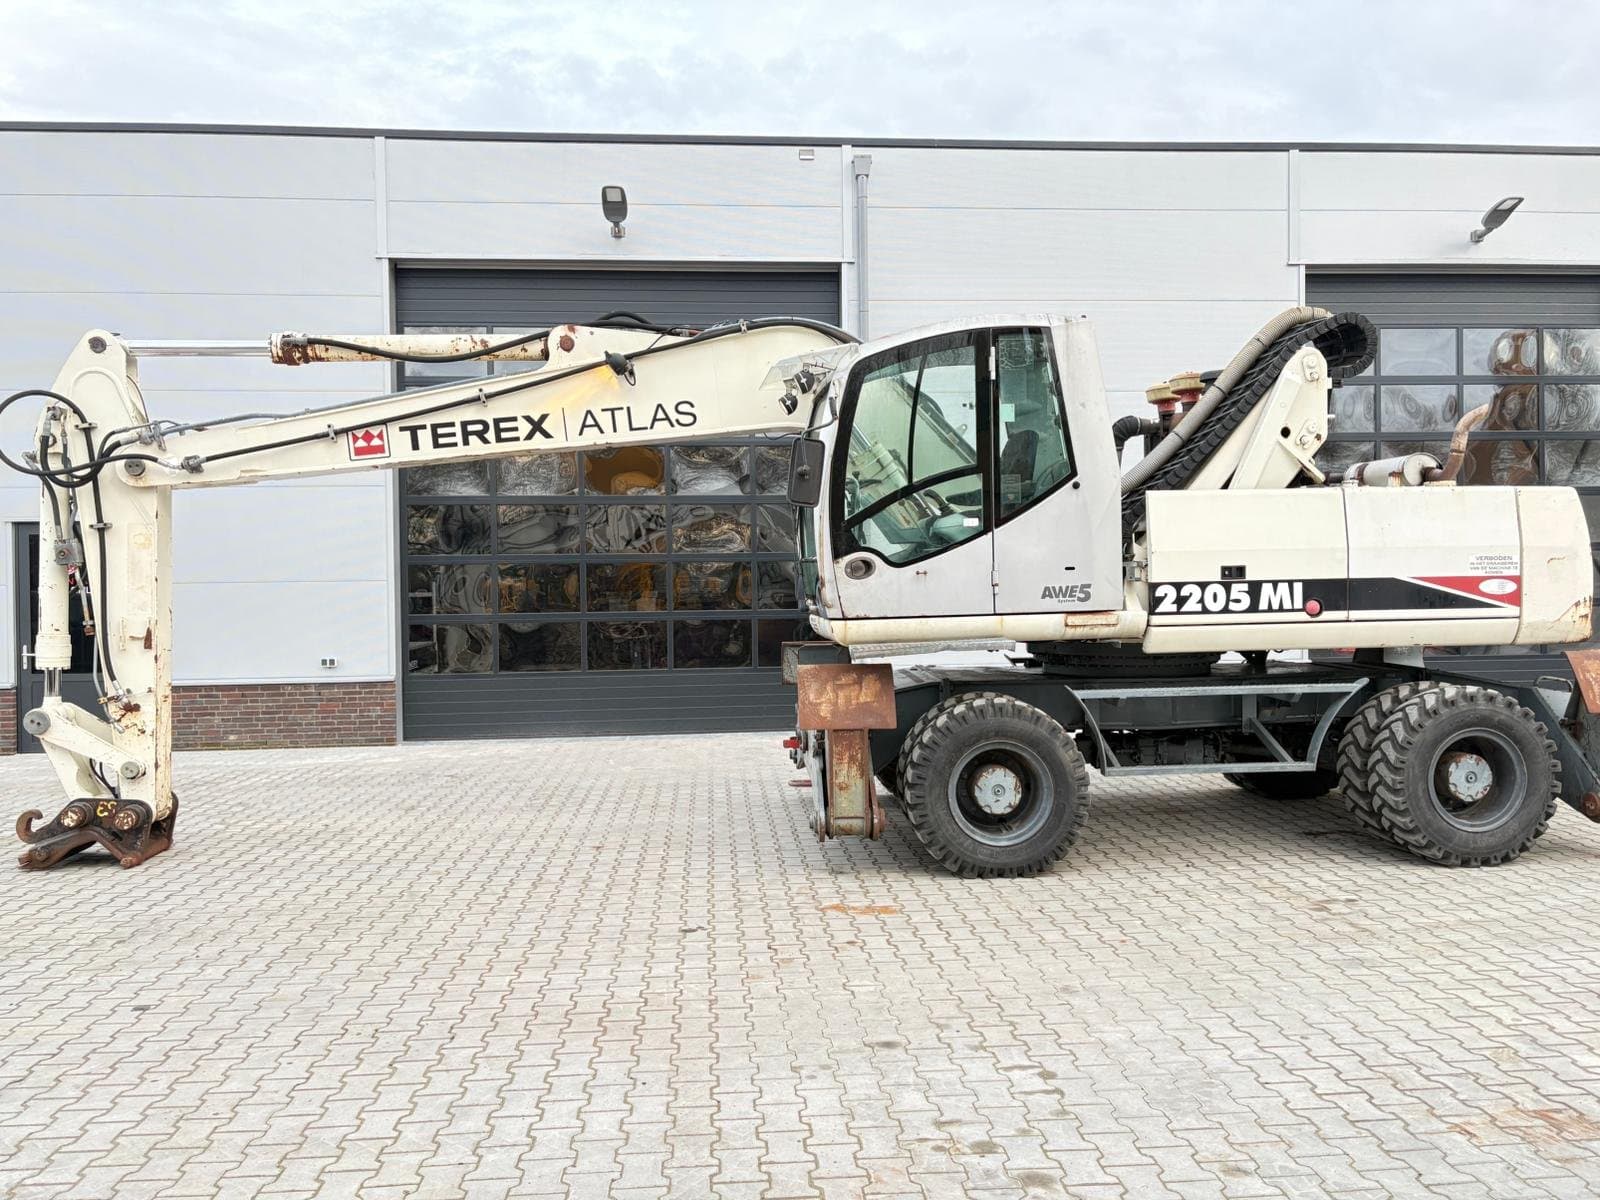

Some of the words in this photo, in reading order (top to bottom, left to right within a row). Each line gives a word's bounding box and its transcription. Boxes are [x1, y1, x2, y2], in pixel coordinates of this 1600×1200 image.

[399, 413, 554, 451] TEREX
[578, 401, 697, 436] ATLAS
[1041, 583, 1092, 603] AWE5
[1154, 582, 1251, 613] 2205
[1258, 581, 1304, 611] MI
